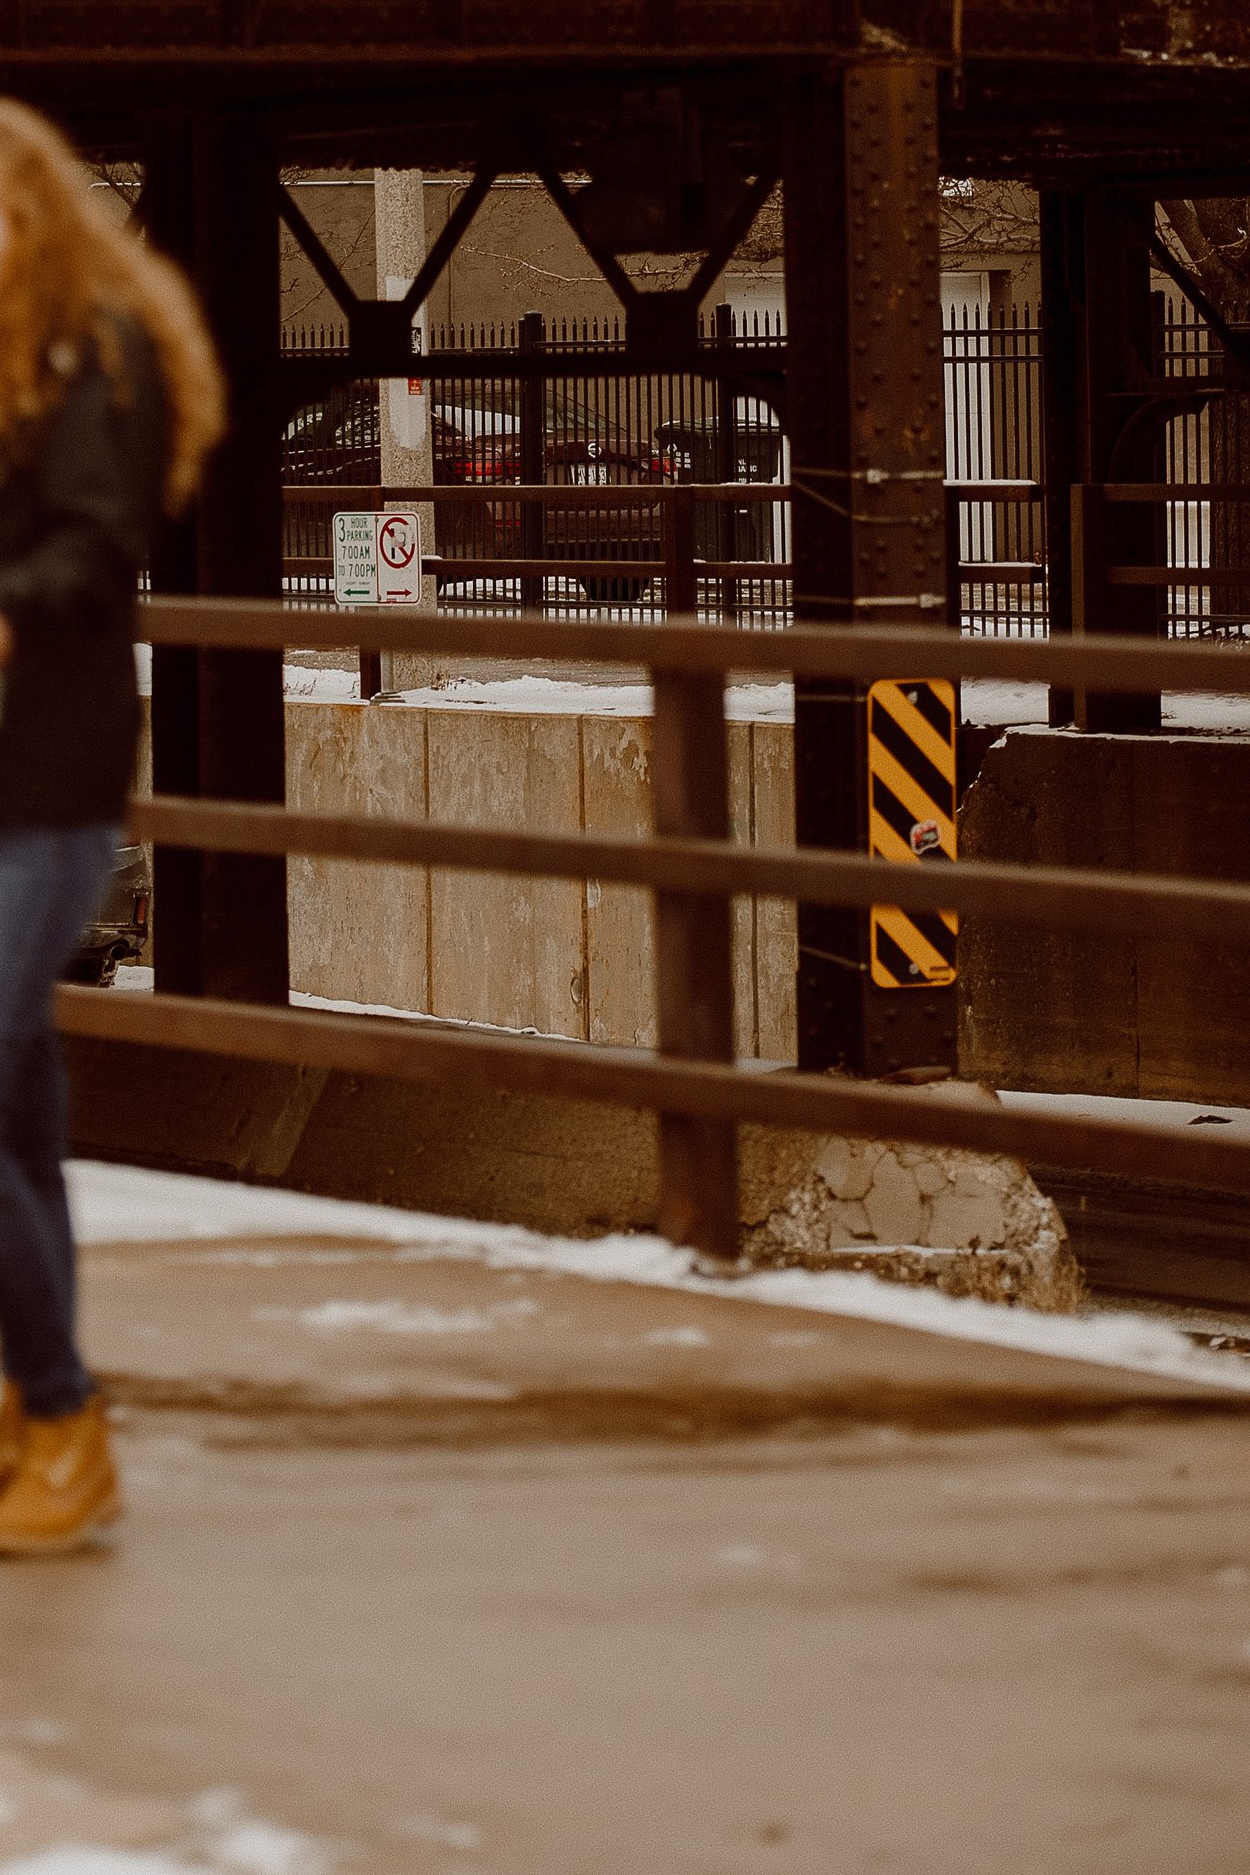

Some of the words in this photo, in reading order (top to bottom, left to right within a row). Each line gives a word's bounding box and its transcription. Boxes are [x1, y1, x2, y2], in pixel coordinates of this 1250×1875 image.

[338, 517, 346, 542] 3
[350, 517, 368, 528] HOUR
[346, 529, 373, 542] PARKING
[338, 564, 346, 576] TO
